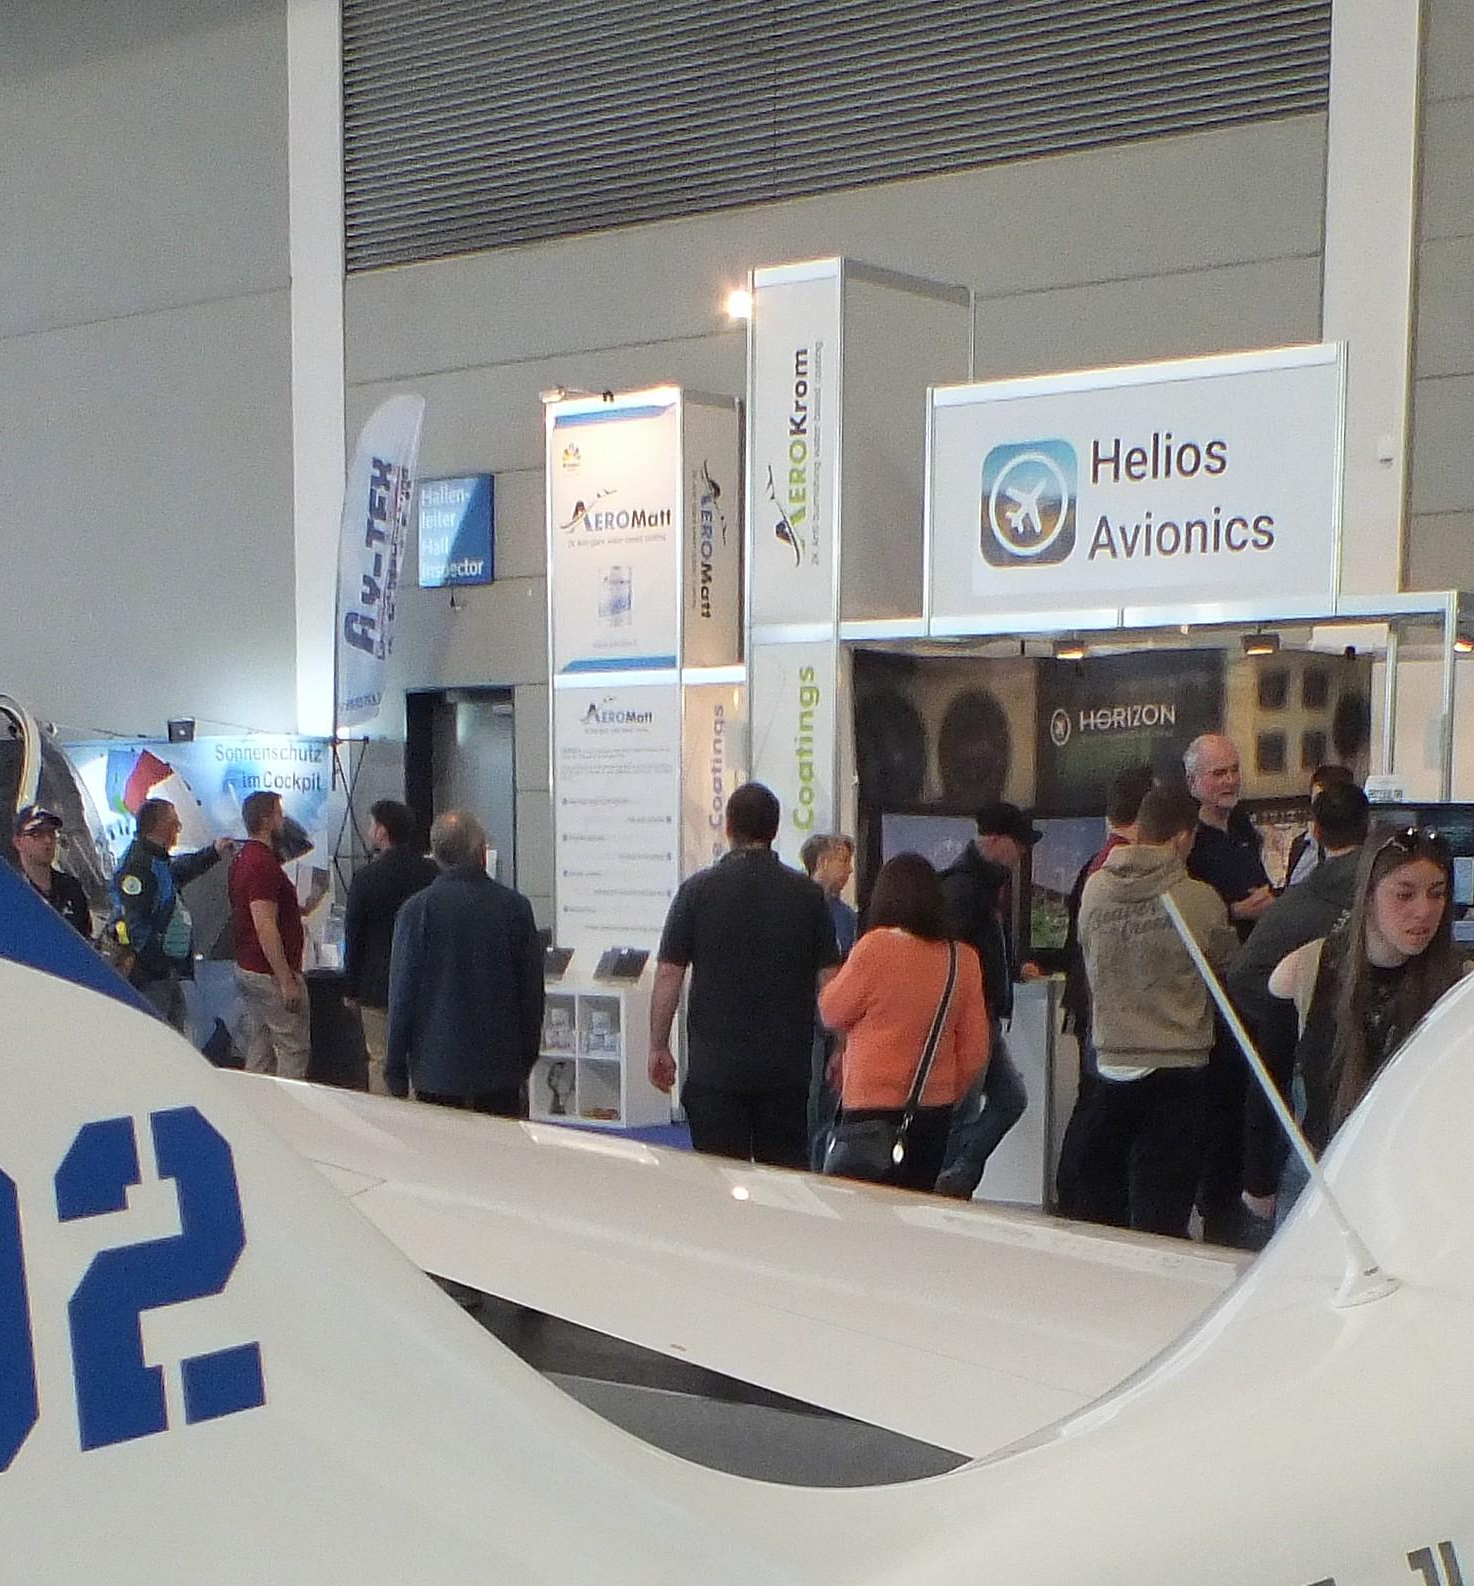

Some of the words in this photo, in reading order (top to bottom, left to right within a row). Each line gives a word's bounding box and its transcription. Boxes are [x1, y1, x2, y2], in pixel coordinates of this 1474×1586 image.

[1091, 432, 1228, 484] Helios
[571, 500, 671, 532] AEROMatt
[1088, 506, 1275, 560] Avionics
[1080, 704, 1175, 731] HORIZON
[214, 743, 323, 764] Sonnenschutz
[709, 704, 725, 831] Coatings
[793, 666, 820, 831] Coatings
[242, 773, 261, 789] im
[264, 771, 322, 793] Cockpit
